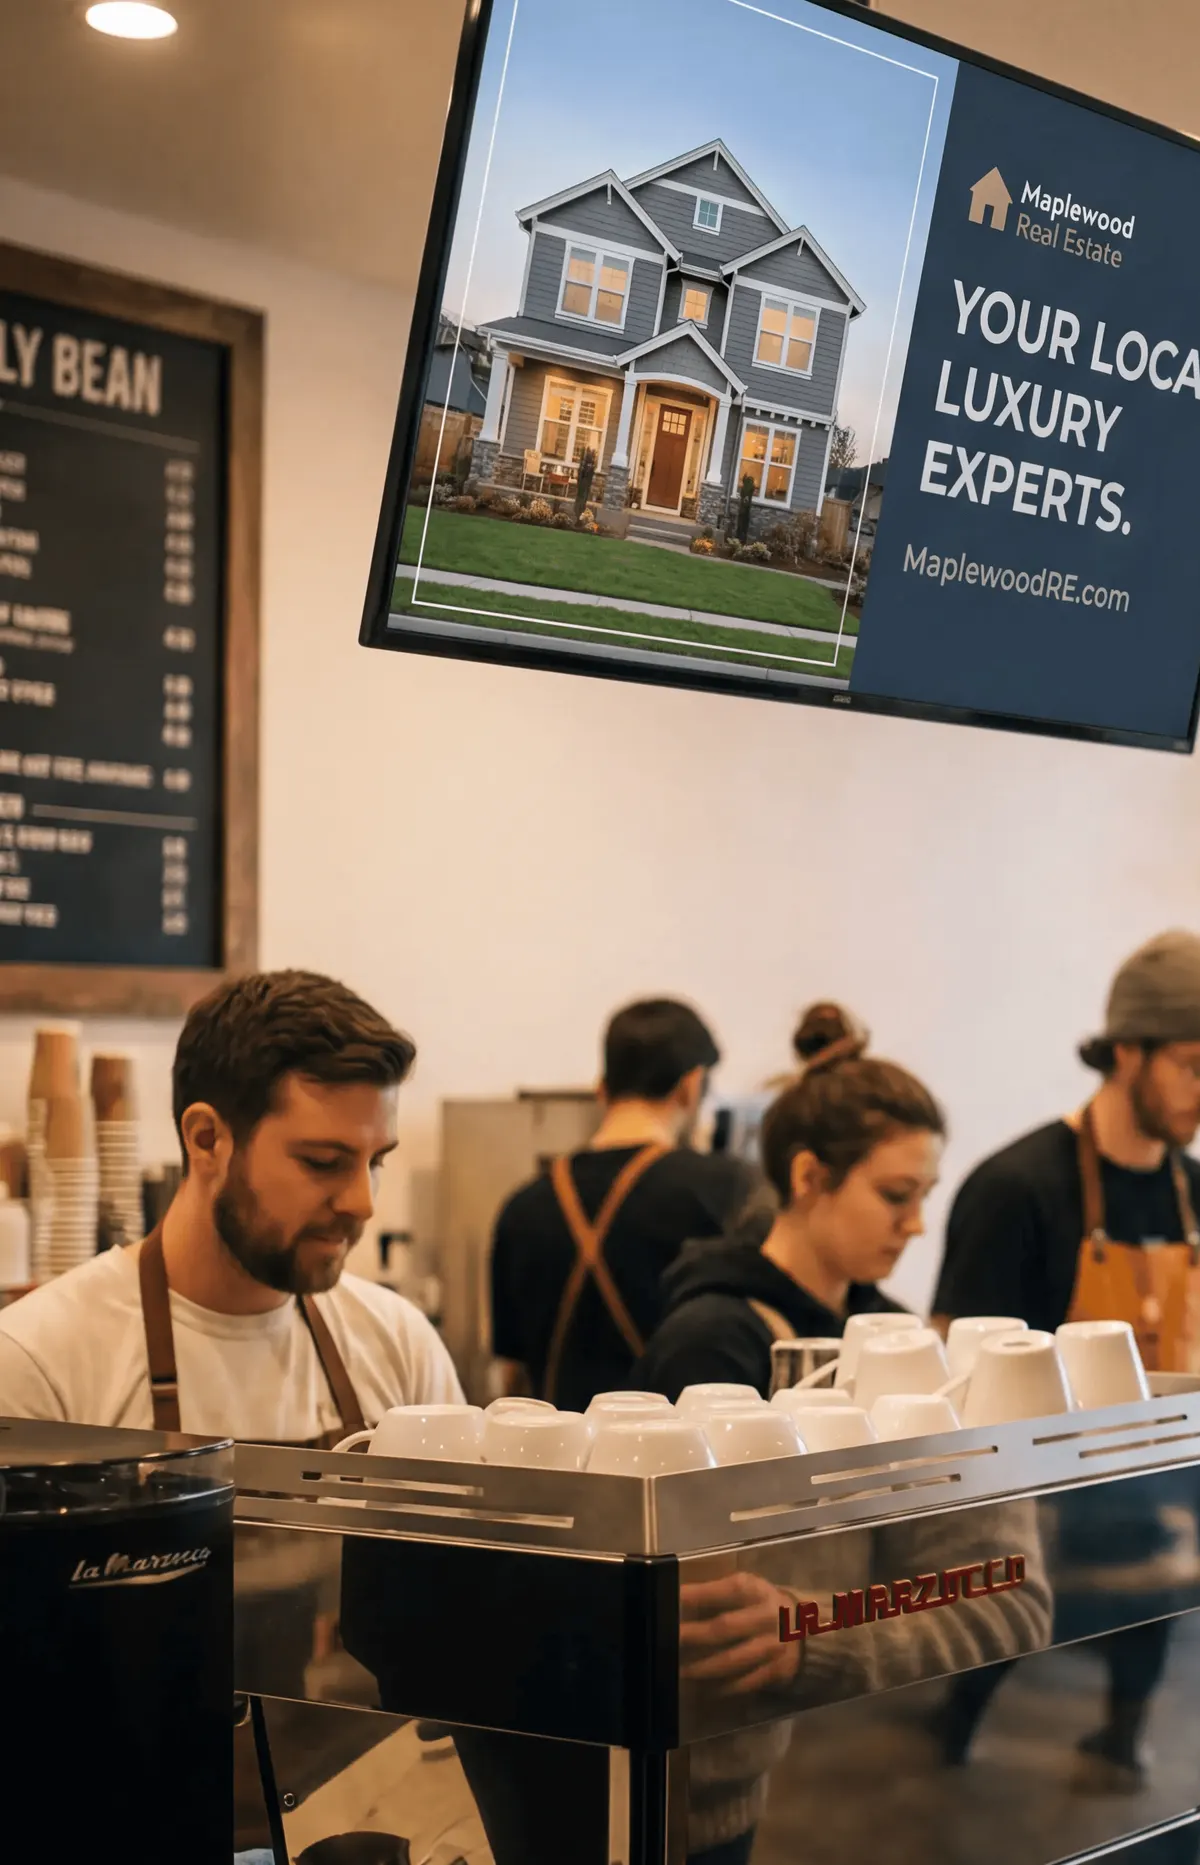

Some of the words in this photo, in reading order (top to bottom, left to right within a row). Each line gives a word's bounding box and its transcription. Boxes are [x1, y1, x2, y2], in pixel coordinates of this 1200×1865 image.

[1015, 212, 1060, 249] Real
[1062, 227, 1123, 269] Estate
[1020, 179, 1136, 240] Maplewood
[953, 278, 1081, 366] YOUR
[52, 332, 162, 417] BEAN
[934, 359, 1124, 453] LUXURY
[919, 439, 1132, 536] EXPERTS.
[902, 543, 1130, 613] MaplewoodRE.com
